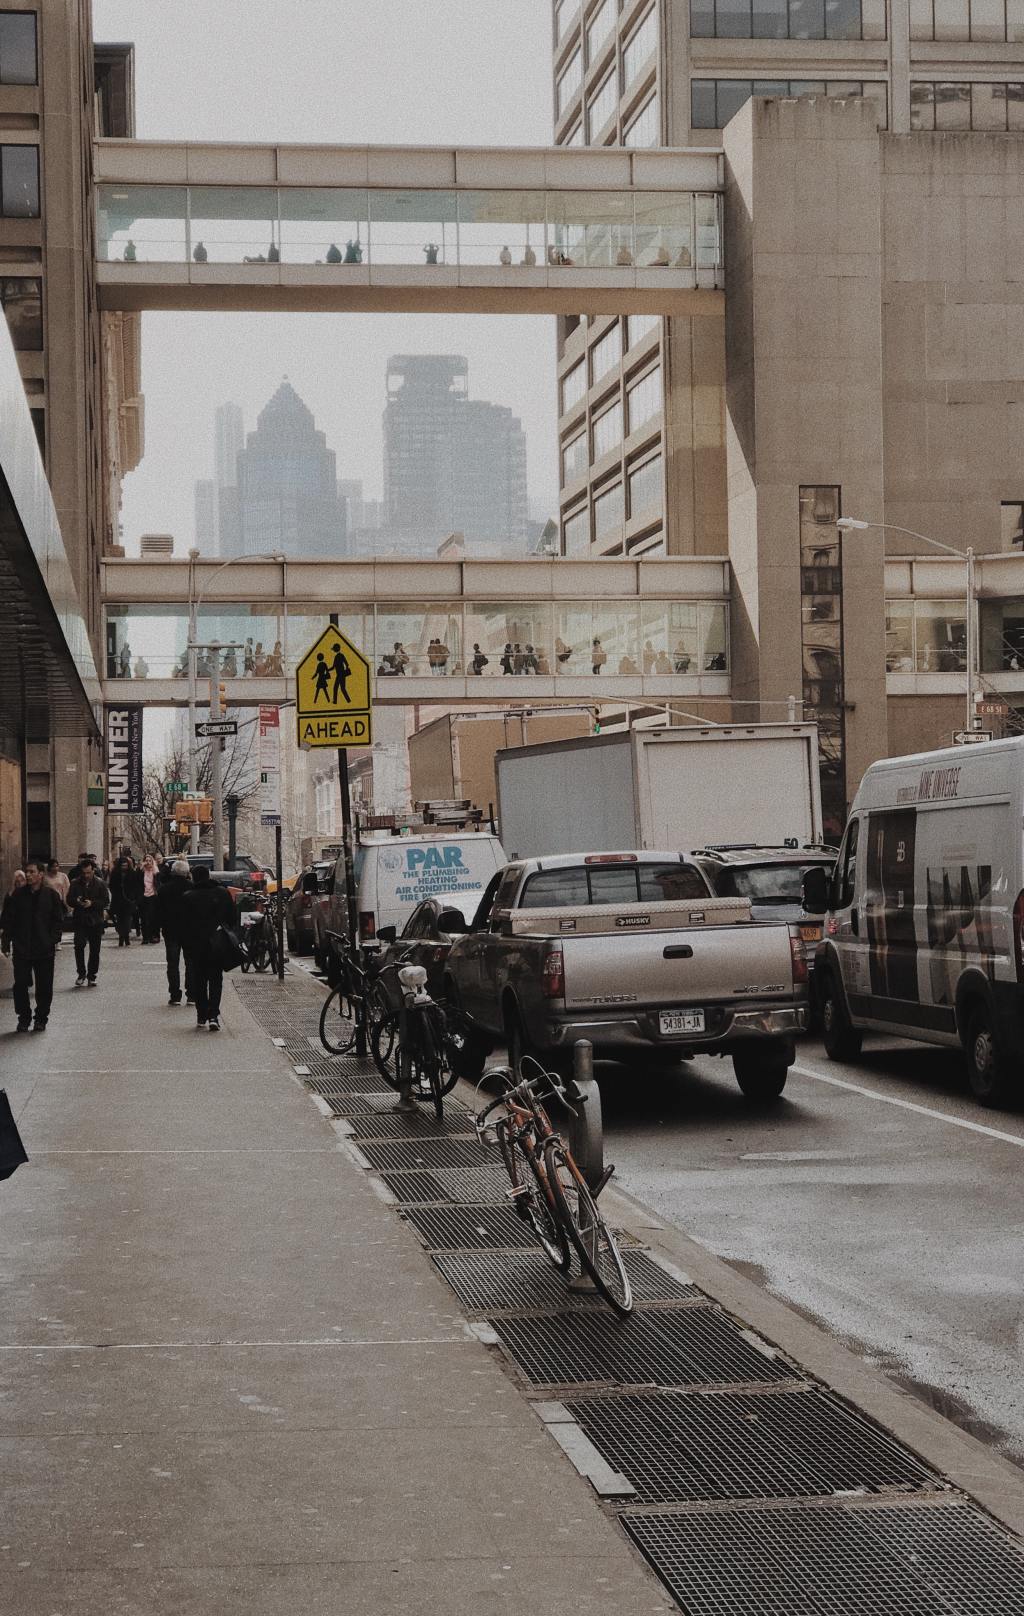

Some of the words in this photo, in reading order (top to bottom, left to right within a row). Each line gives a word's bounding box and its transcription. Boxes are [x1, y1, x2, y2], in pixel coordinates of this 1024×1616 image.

[981, 705, 985, 713] E
[986, 705, 994, 713] 68
[131, 711, 139, 726] York
[304, 721, 366, 739] AHEAD
[131, 742, 139, 750] of
[108, 711, 129, 809] HUNTER
[131, 751, 140, 782] University
[131, 784, 140, 797] City
[174, 783, 182, 791] 68
[784, 838, 799, 849] 50
[406, 846, 465, 870] PAR
[402, 871, 419, 879] THE
[422, 868, 470, 877] PLUMBING
[417, 876, 458, 885] HEATING
[395, 886, 412, 894] AIR
[413, 882, 482, 893] CONDITIONING
[625, 916, 650, 925] HUSKY
